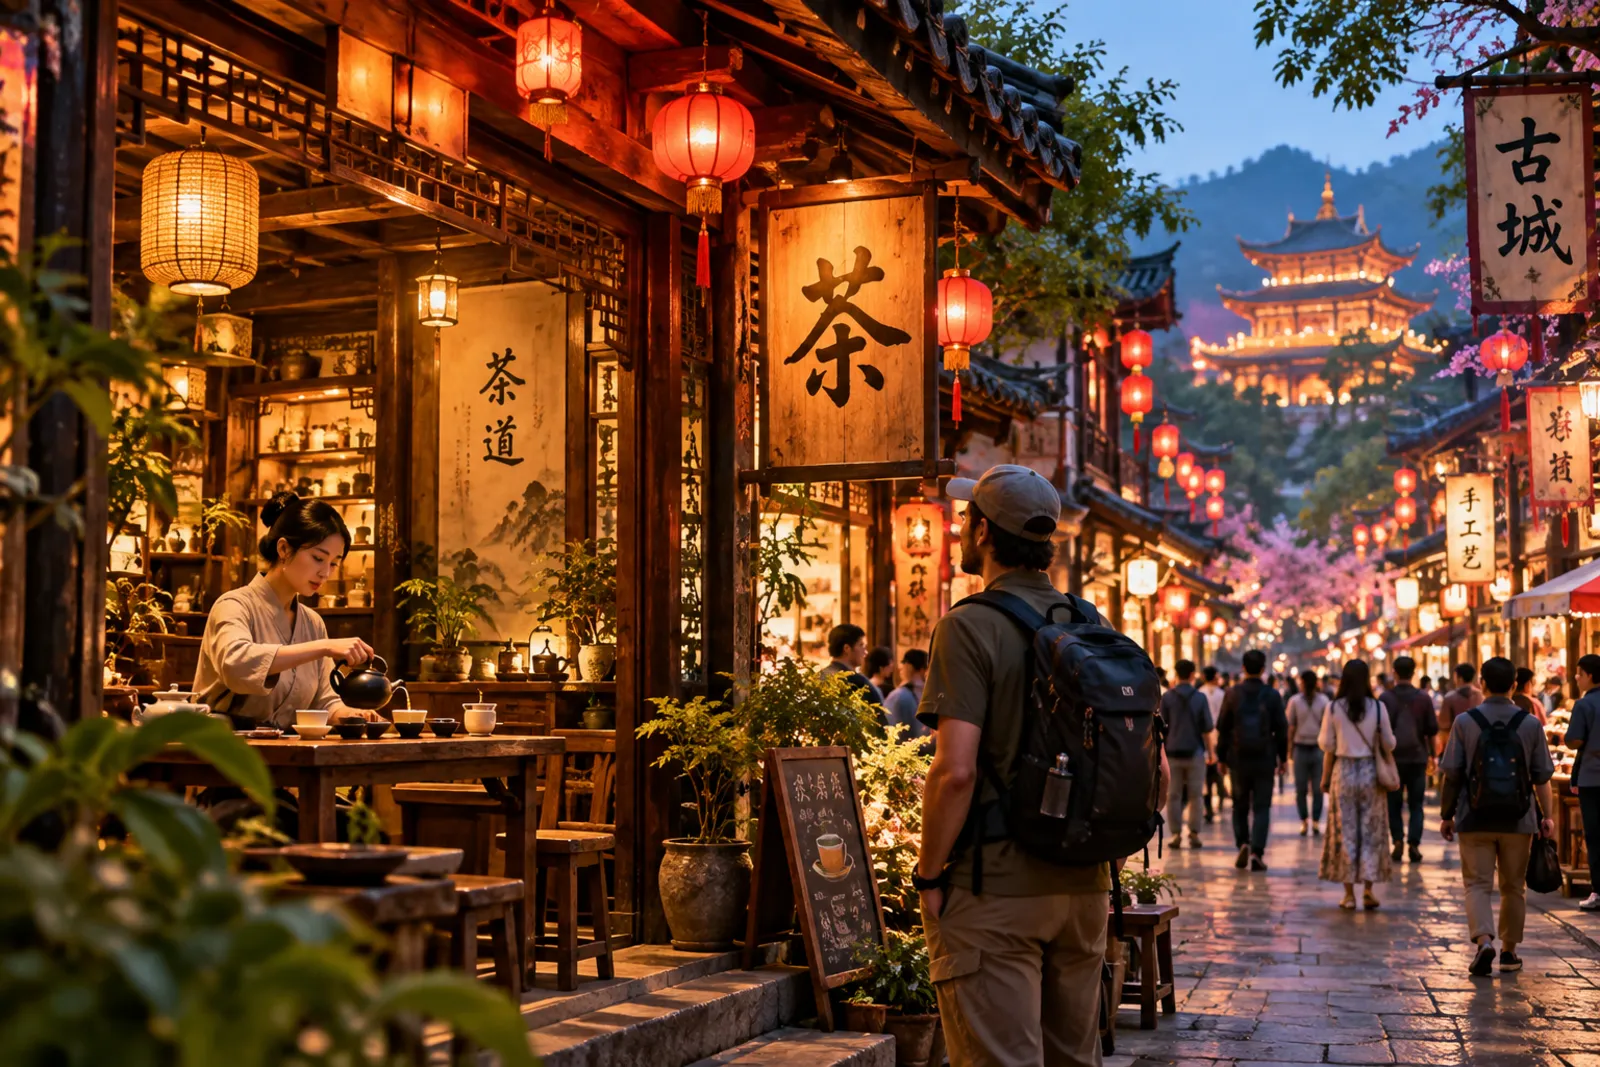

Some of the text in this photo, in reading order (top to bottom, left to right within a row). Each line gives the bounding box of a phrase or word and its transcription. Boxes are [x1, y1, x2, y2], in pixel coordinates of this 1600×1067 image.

[1495, 117, 1573, 265] 古城
[784, 246, 912, 408] 茶
[479, 348, 526, 467] 茶道
[1459, 487, 1482, 569] 手工艺
